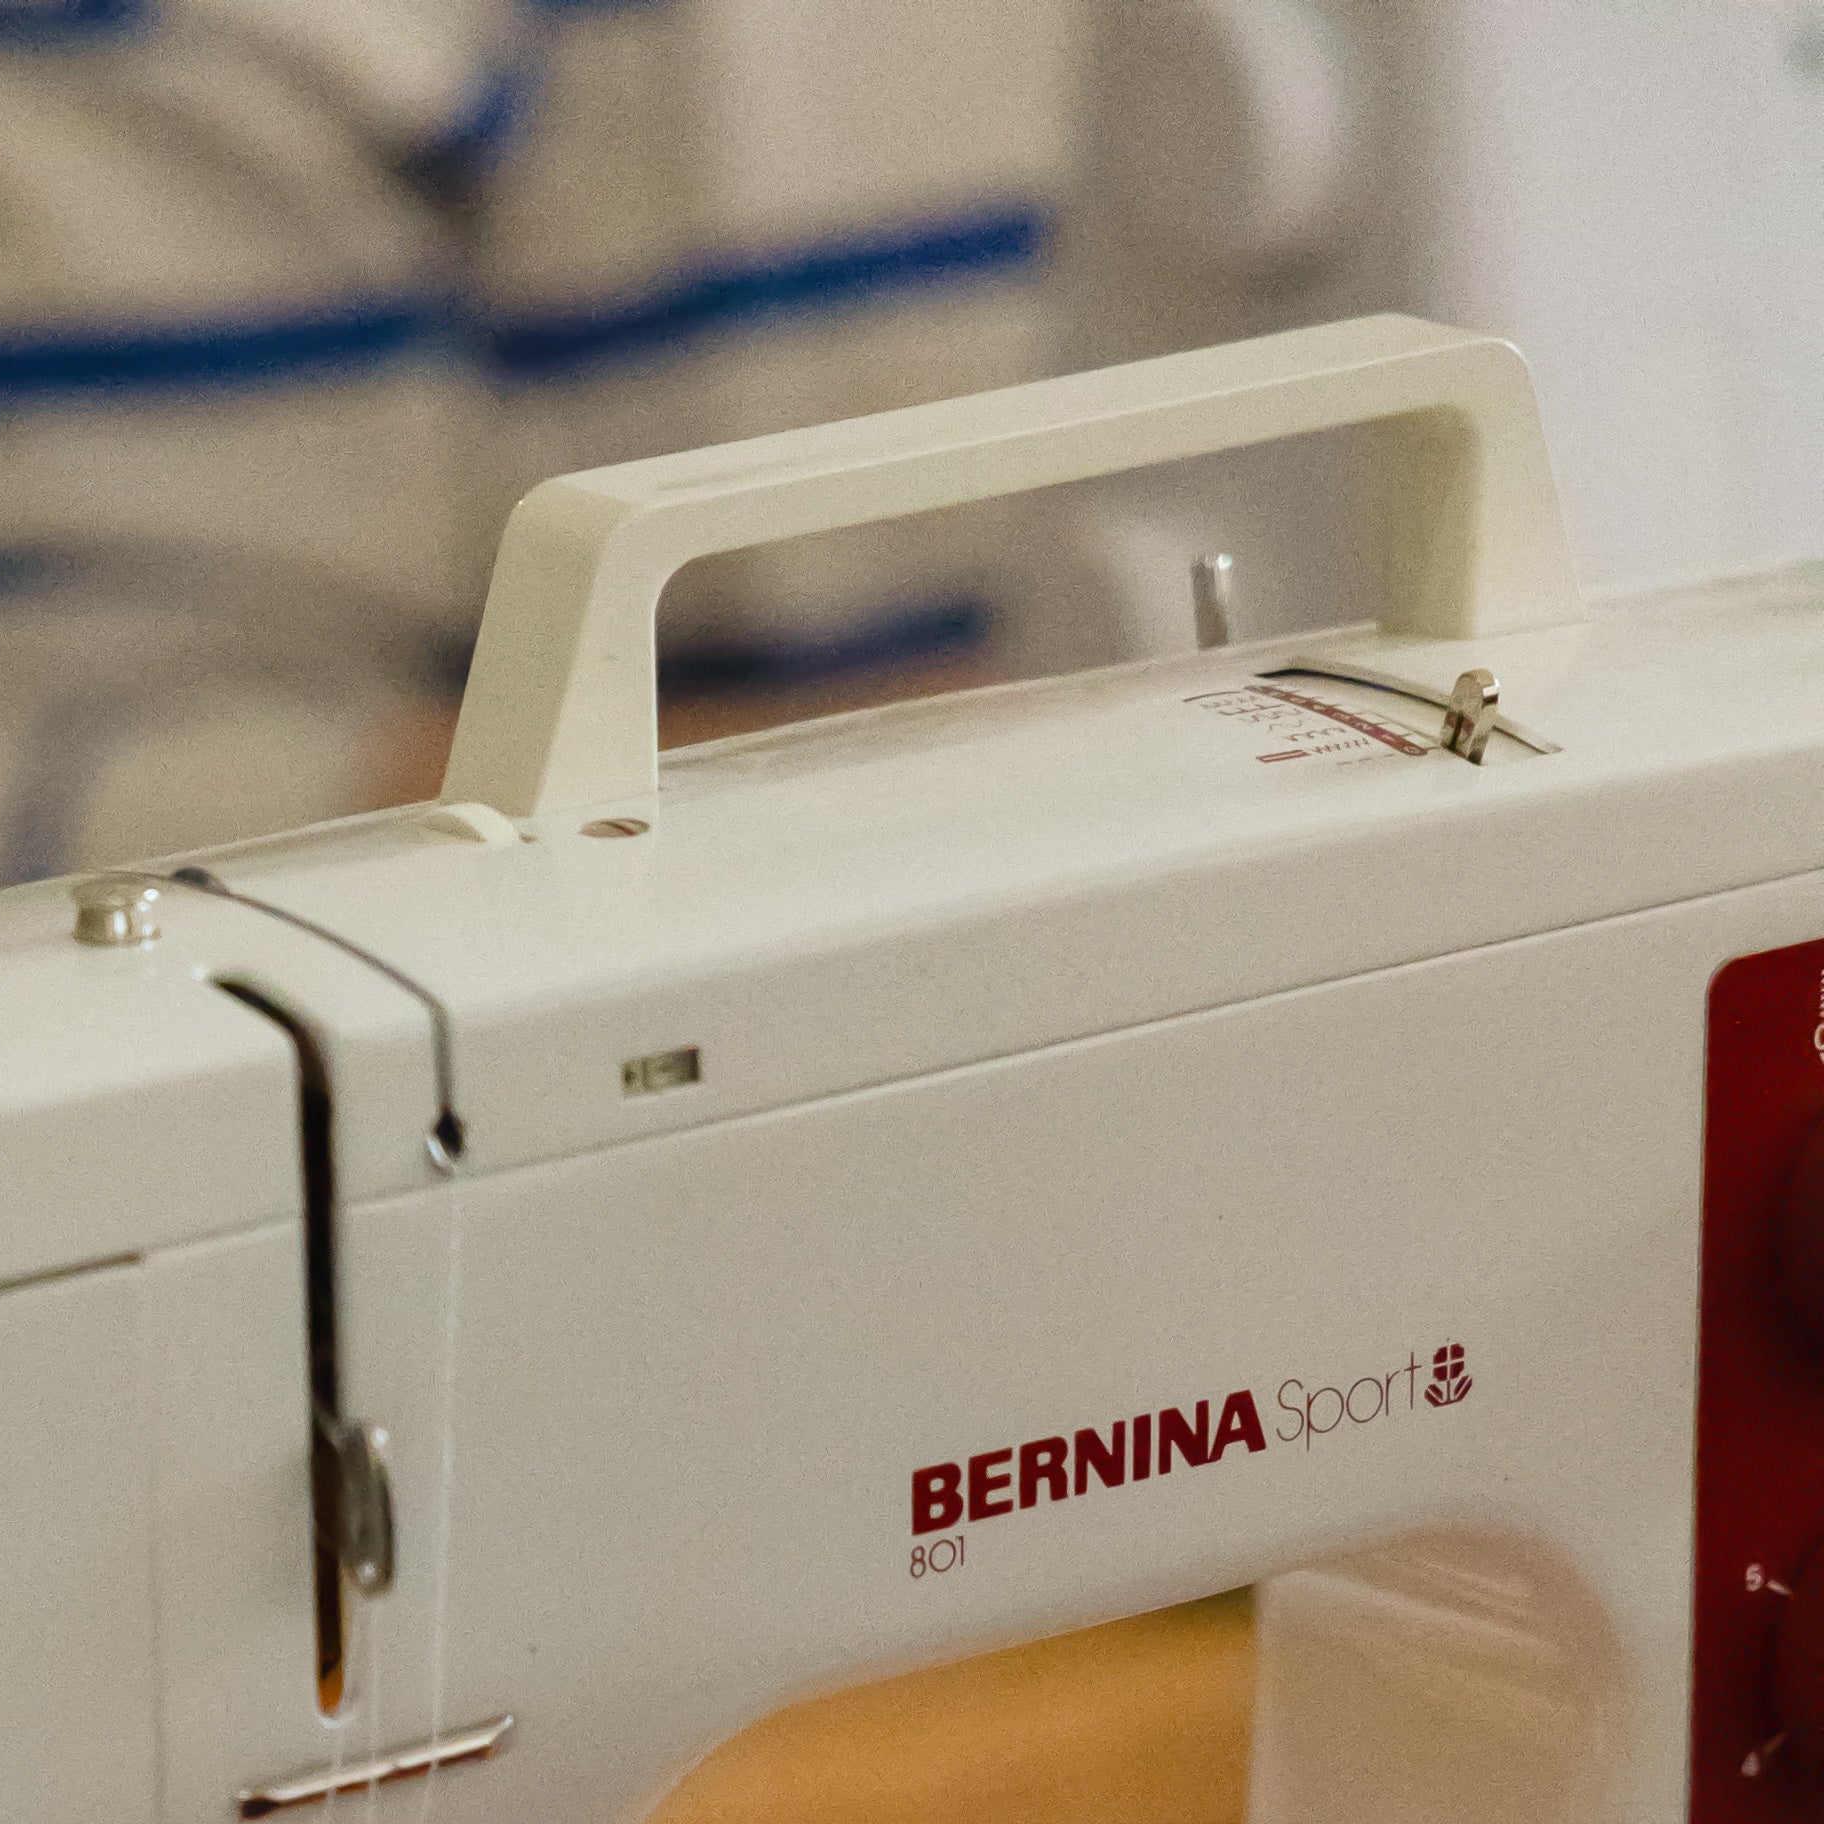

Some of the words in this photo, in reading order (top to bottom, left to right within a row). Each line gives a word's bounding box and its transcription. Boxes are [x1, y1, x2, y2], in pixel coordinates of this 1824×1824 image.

[911, 1389, 1267, 1536] BERNINA
[1275, 1350, 1423, 1452] Sport
[908, 1534, 967, 1580] 801
